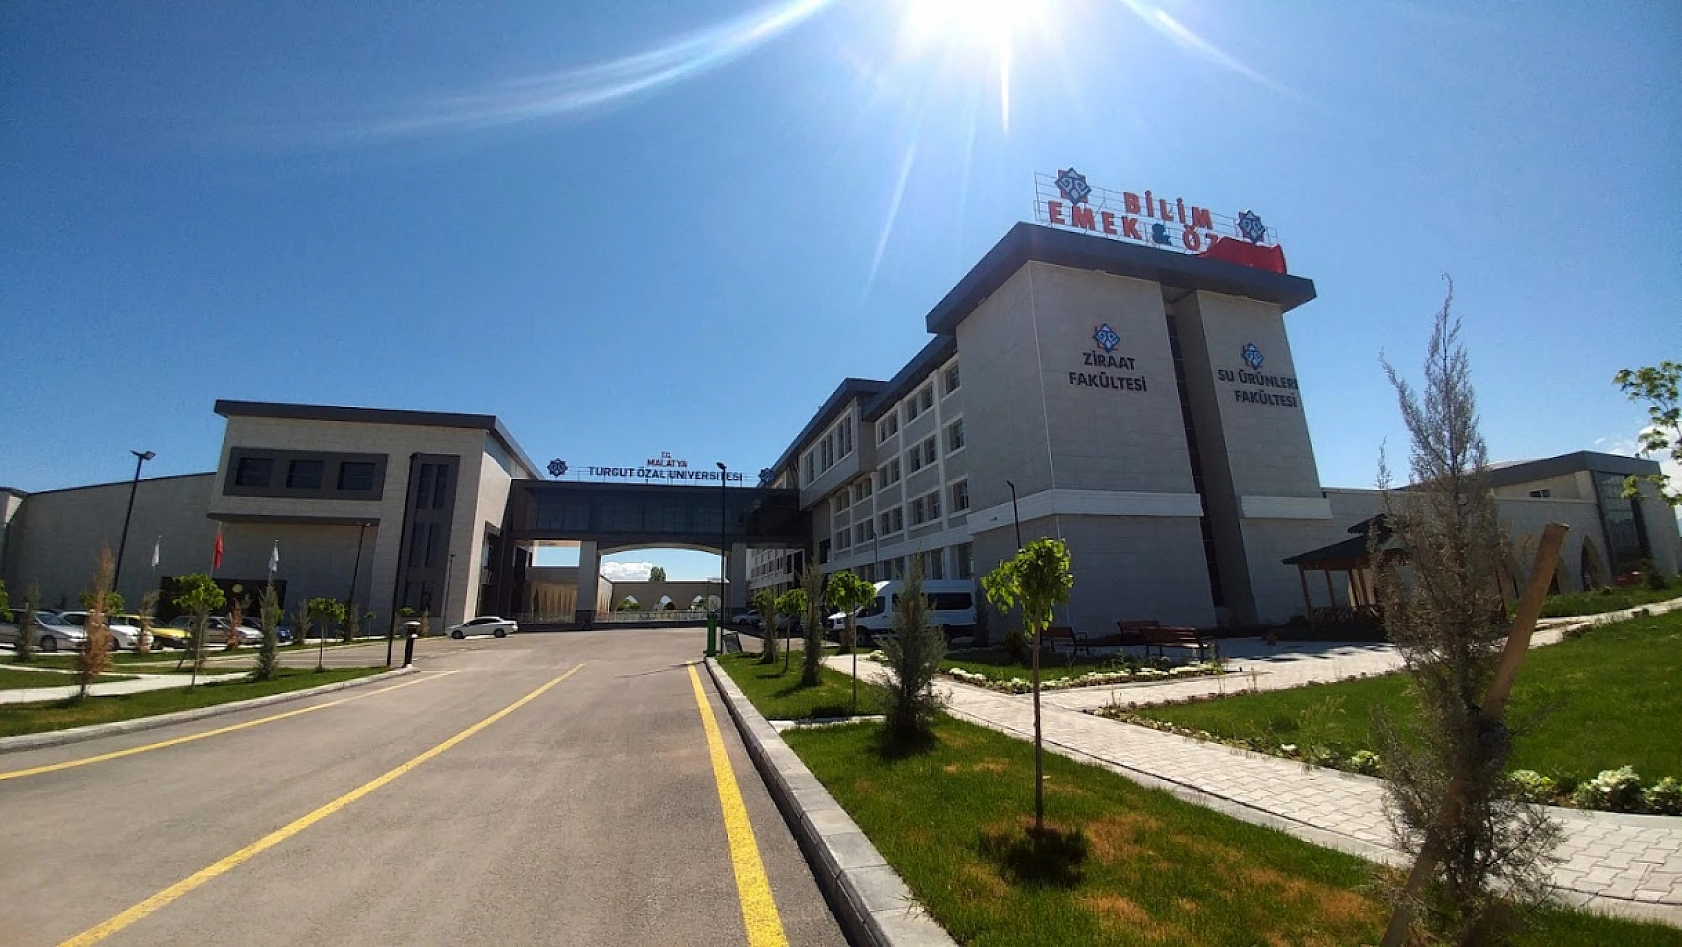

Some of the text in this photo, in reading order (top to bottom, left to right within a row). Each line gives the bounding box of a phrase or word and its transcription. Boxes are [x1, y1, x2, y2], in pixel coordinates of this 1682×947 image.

[1123, 190, 1213, 230] BİLİM
[1048, 200, 1142, 240] EMEK
[1152, 222, 1171, 246] &
[1083, 351, 1135, 370] ZİRAAT
[1069, 371, 1147, 392] FAKÜLTESİ
[1218, 369, 1234, 382] SU
[1235, 389, 1298, 408] FAKÜLTESİ
[588, 466, 634, 477] TURGUT
[637, 466, 666, 479] ÖZAL
[647, 459, 687, 468] MALATYA
